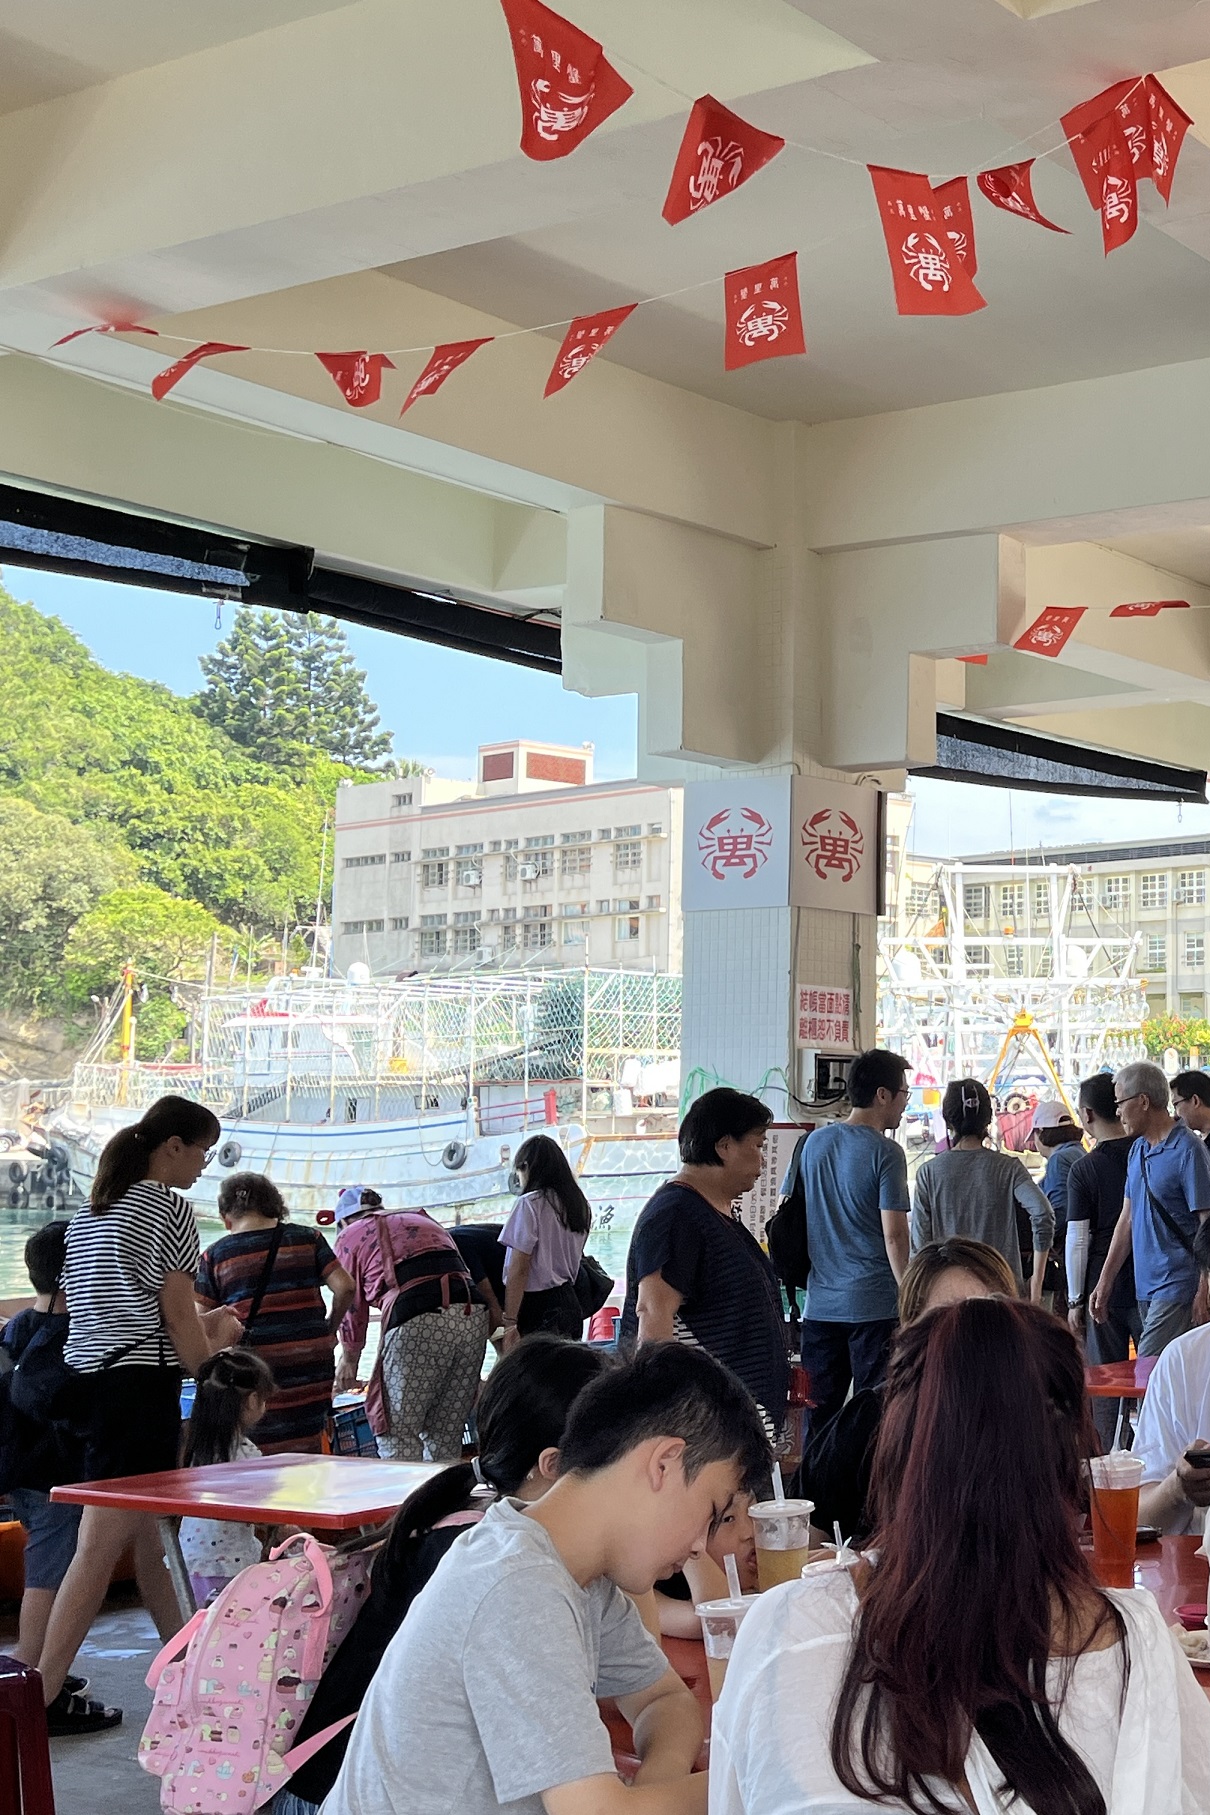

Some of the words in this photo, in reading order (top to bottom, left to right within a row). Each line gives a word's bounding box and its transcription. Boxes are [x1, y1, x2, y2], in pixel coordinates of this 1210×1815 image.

[800, 989, 850, 1016] 結帳當面點清
